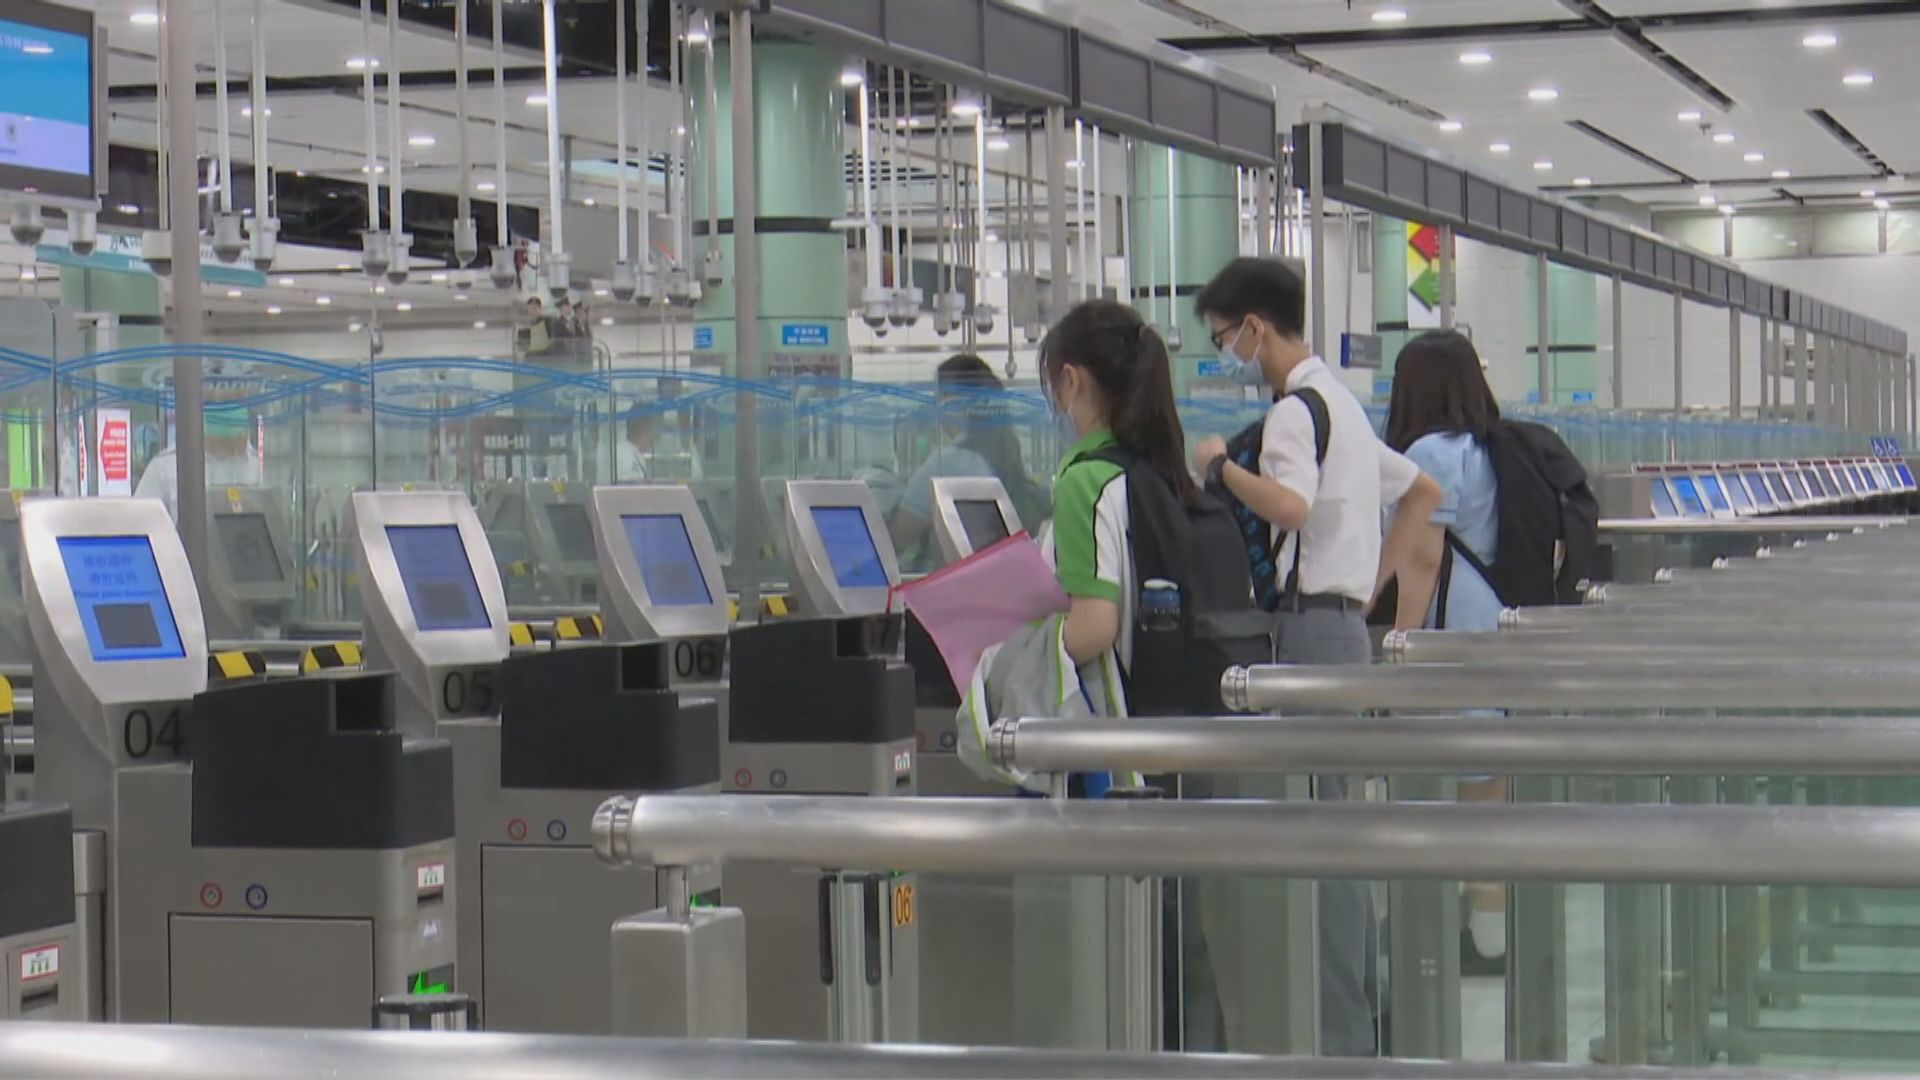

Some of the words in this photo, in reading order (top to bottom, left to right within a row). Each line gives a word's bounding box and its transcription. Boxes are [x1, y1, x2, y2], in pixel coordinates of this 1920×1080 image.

[675, 641, 718, 677] 06
[443, 671, 494, 714] 05
[124, 706, 187, 758] 04
[895, 886, 912, 925] 06
